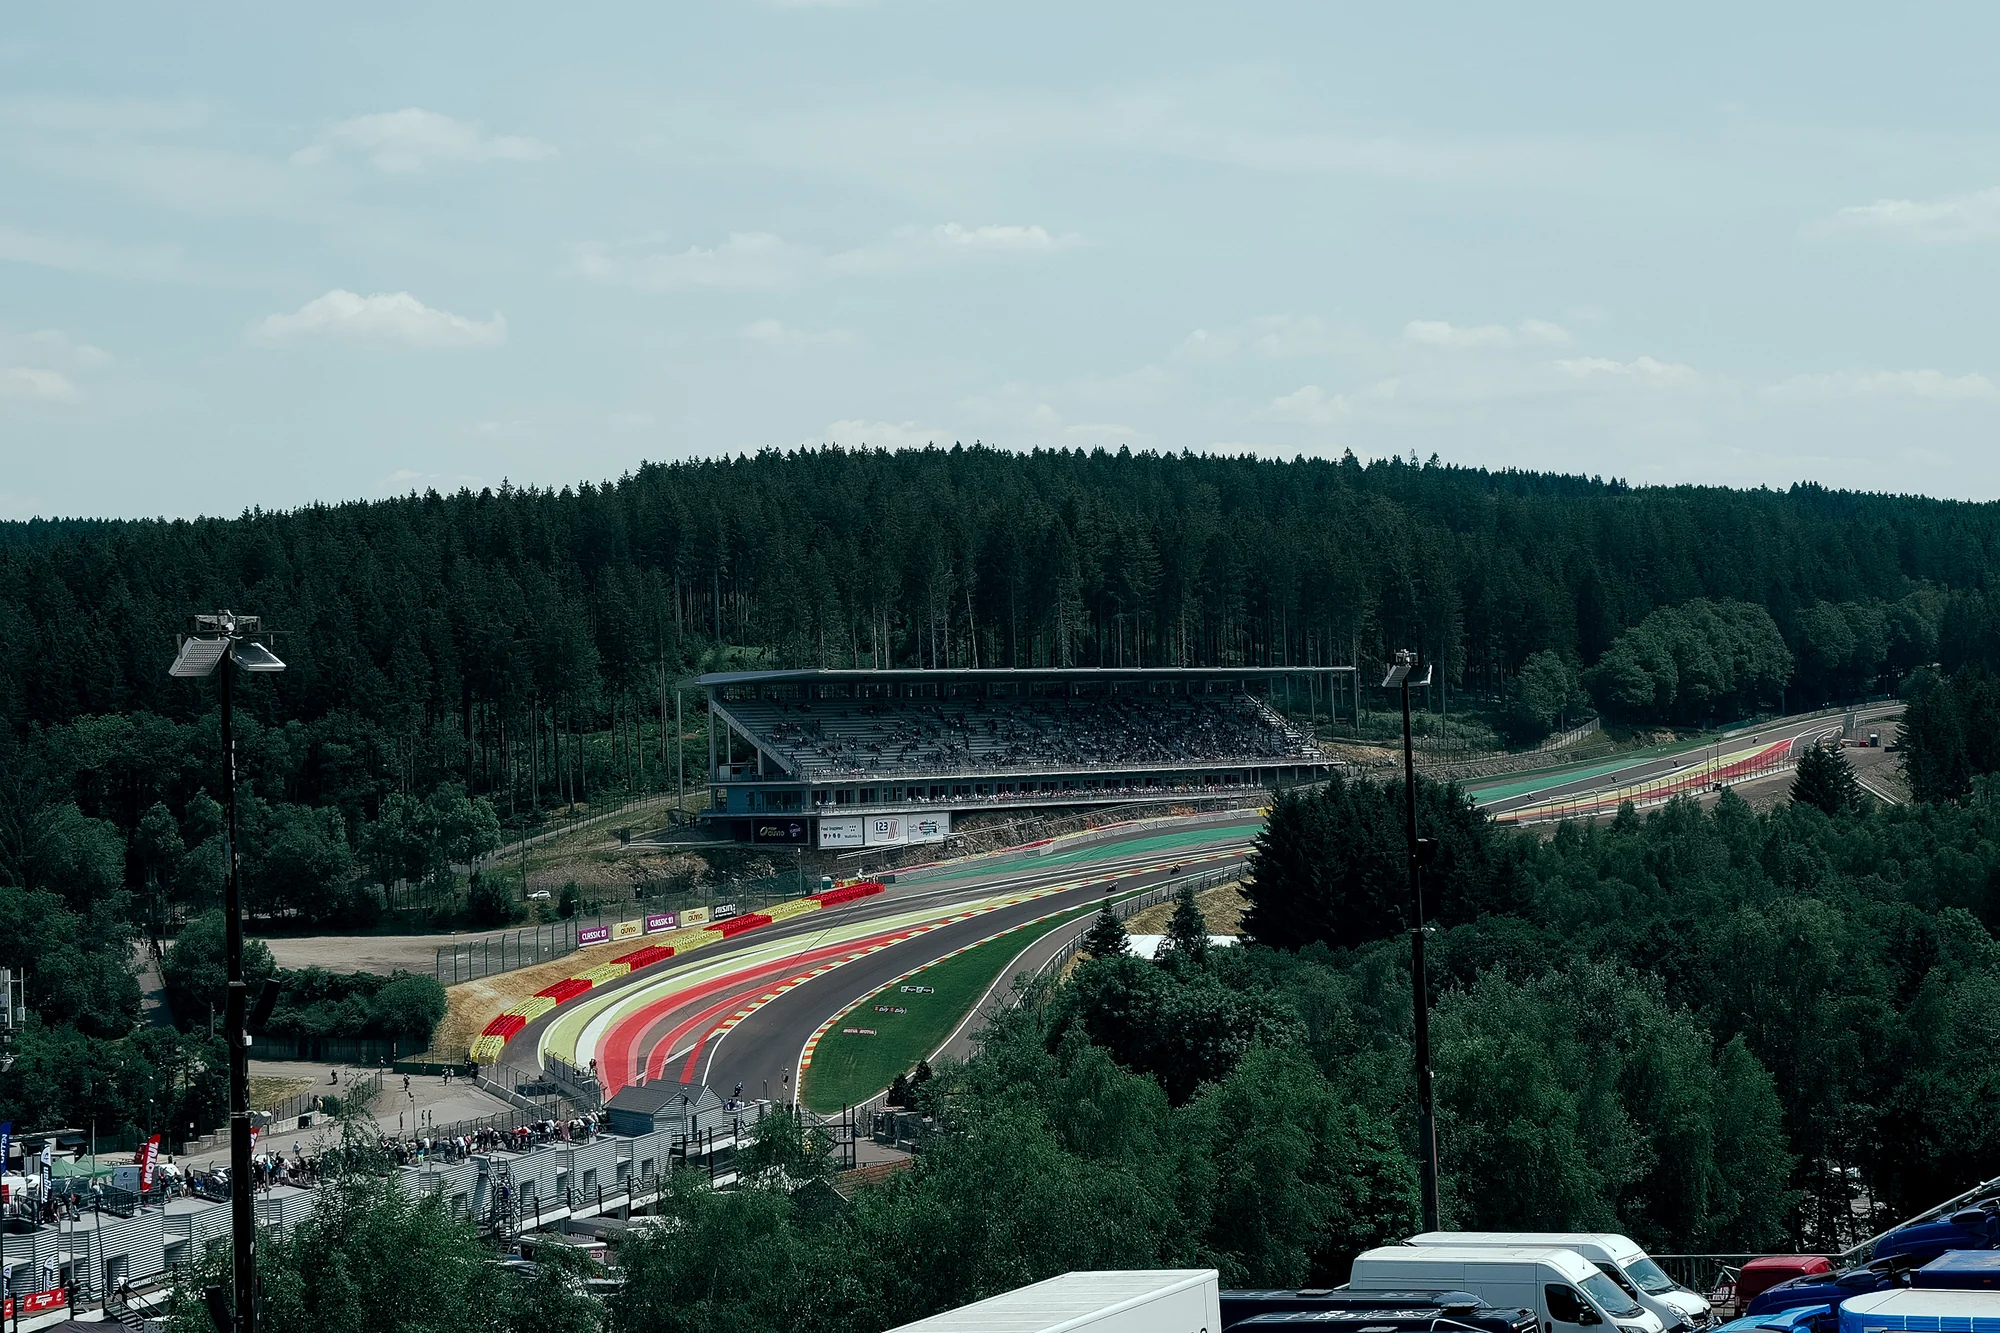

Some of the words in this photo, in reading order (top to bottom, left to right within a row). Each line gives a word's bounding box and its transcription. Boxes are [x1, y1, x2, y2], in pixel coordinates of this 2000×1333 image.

[876, 822, 888, 831] 123
[650, 917, 668, 927] CLASSIC
[582, 930, 601, 940] CLASSIC
[144, 1141, 158, 1184] MOTUL
